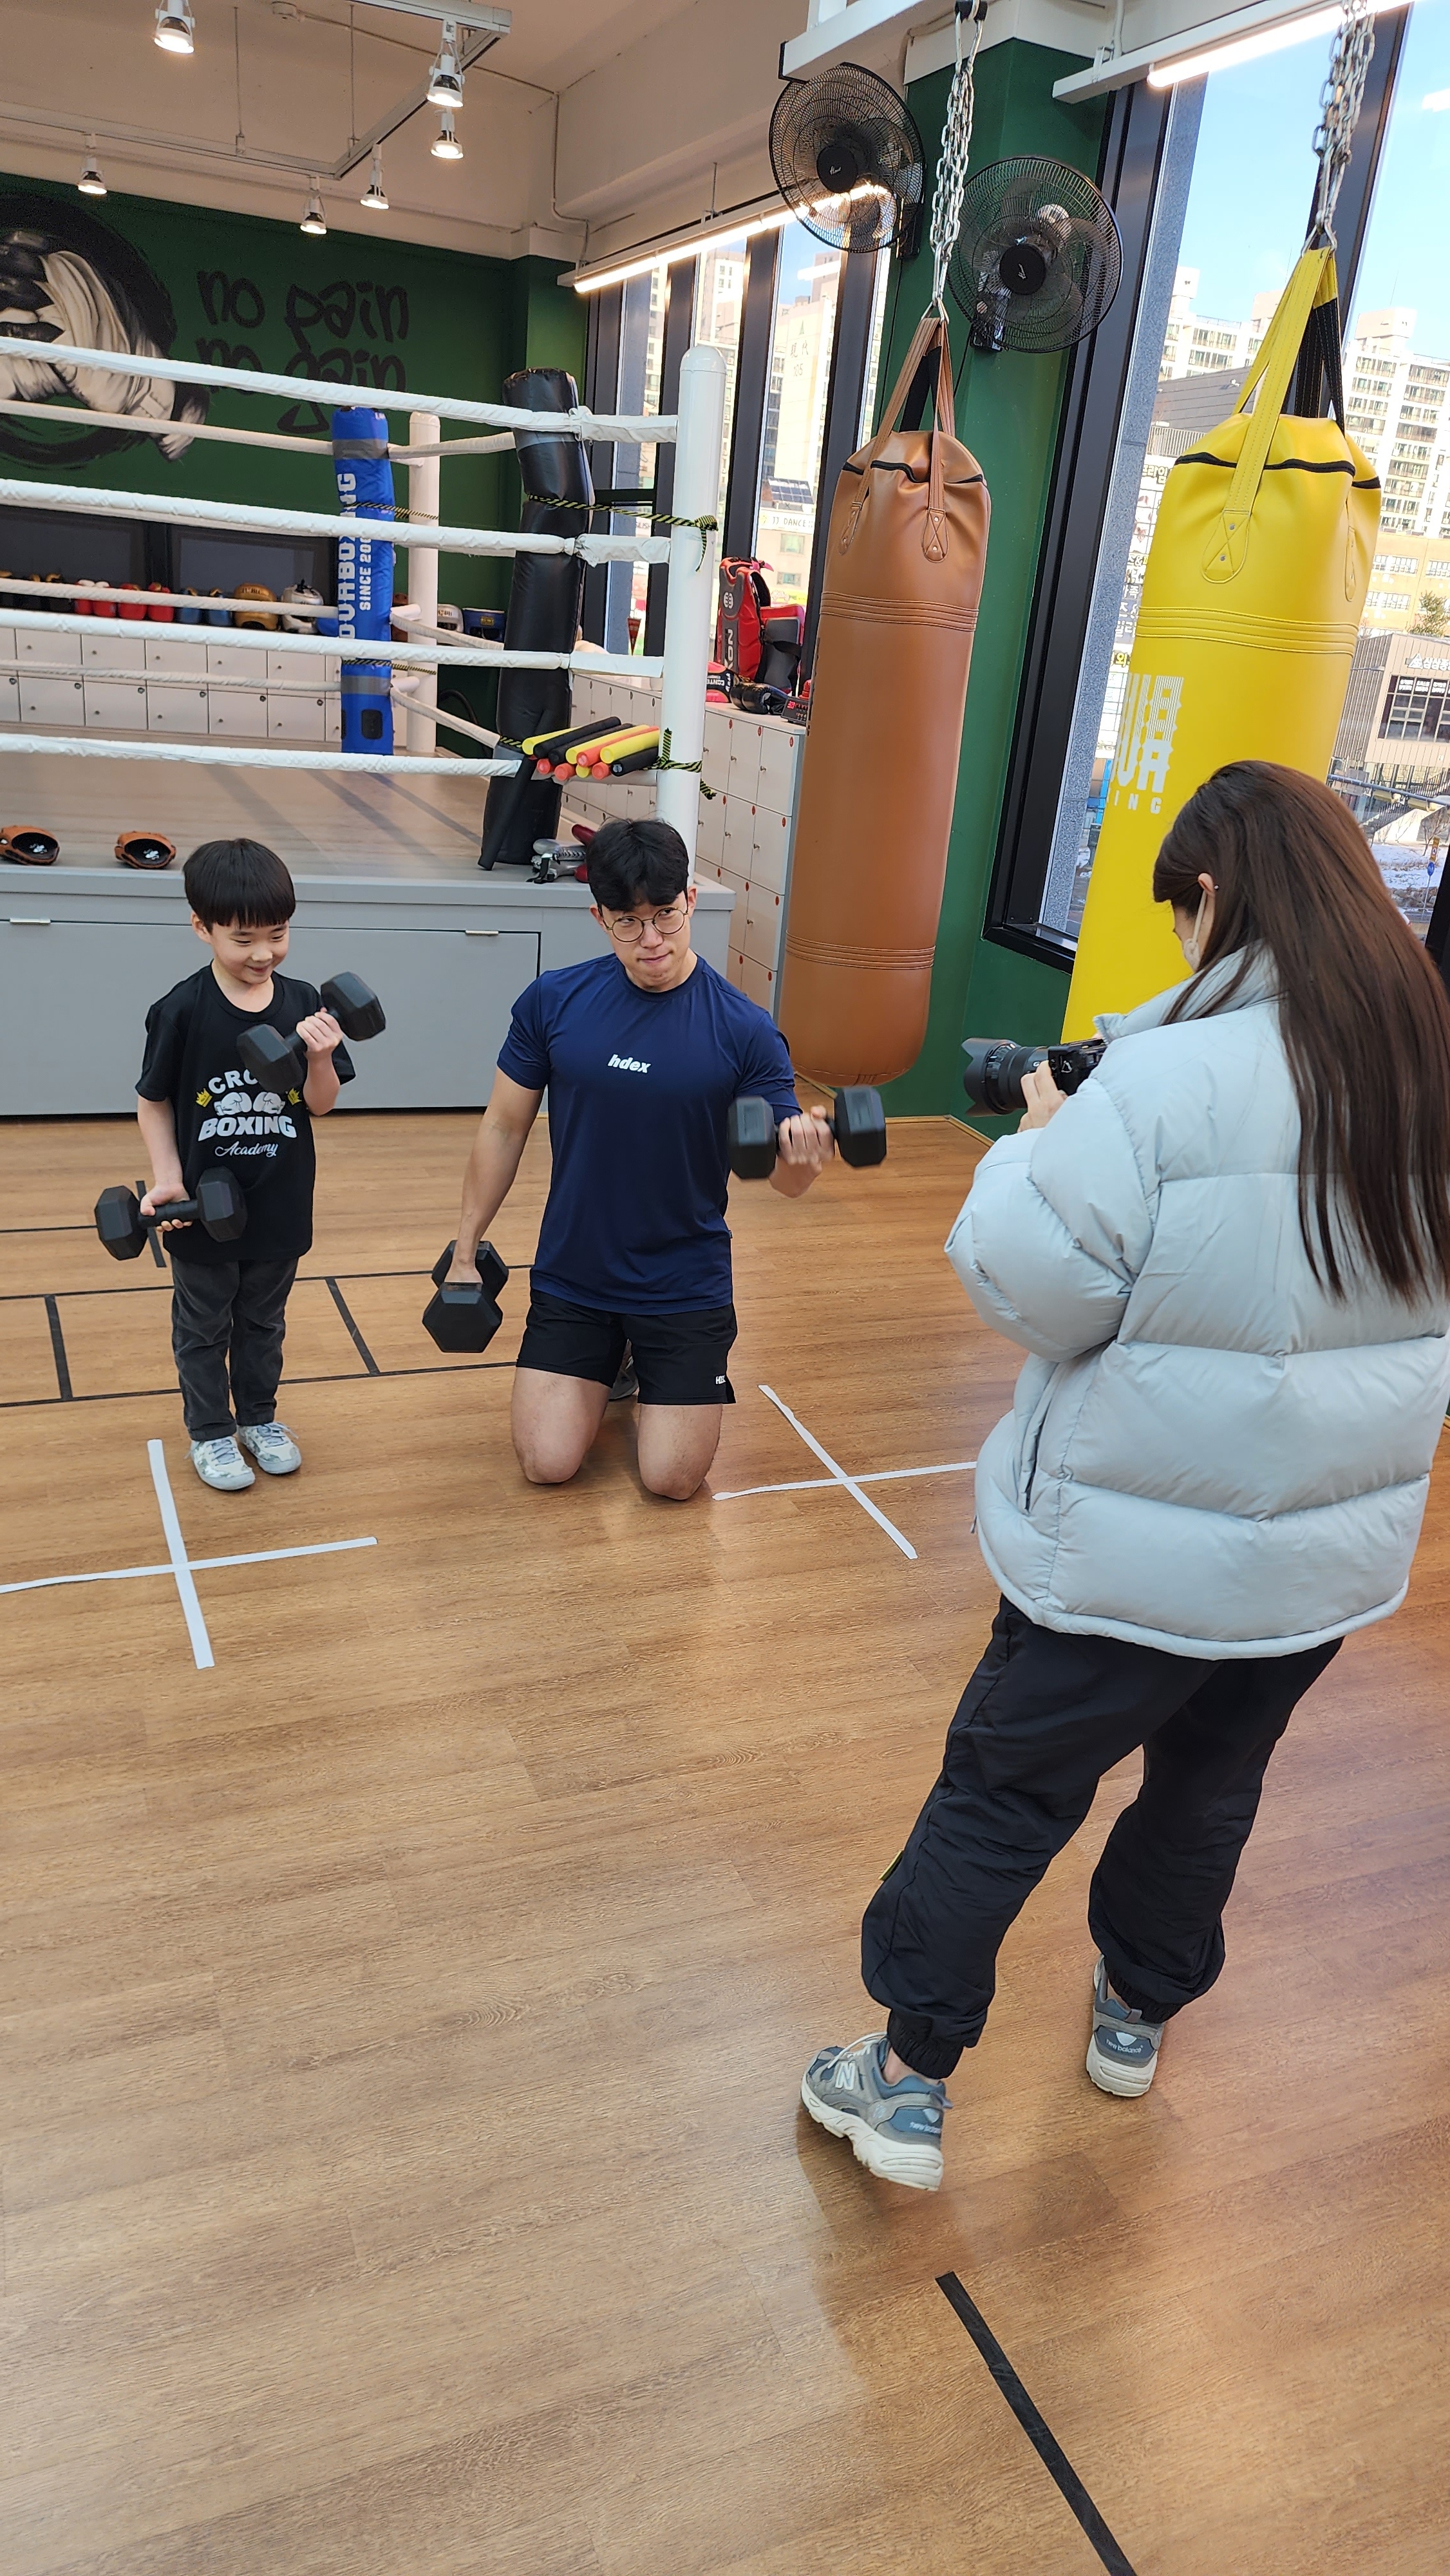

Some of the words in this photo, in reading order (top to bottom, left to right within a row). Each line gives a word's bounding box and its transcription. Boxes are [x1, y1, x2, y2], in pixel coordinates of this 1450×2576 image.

[196, 270, 265, 328] no
[285, 280, 410, 353] pain
[359, 567, 372, 611] SINCE
[1106, 788, 1162, 815] ING
[607, 1054, 652, 1074] hdex
[198, 1115, 297, 1142] BOXING
